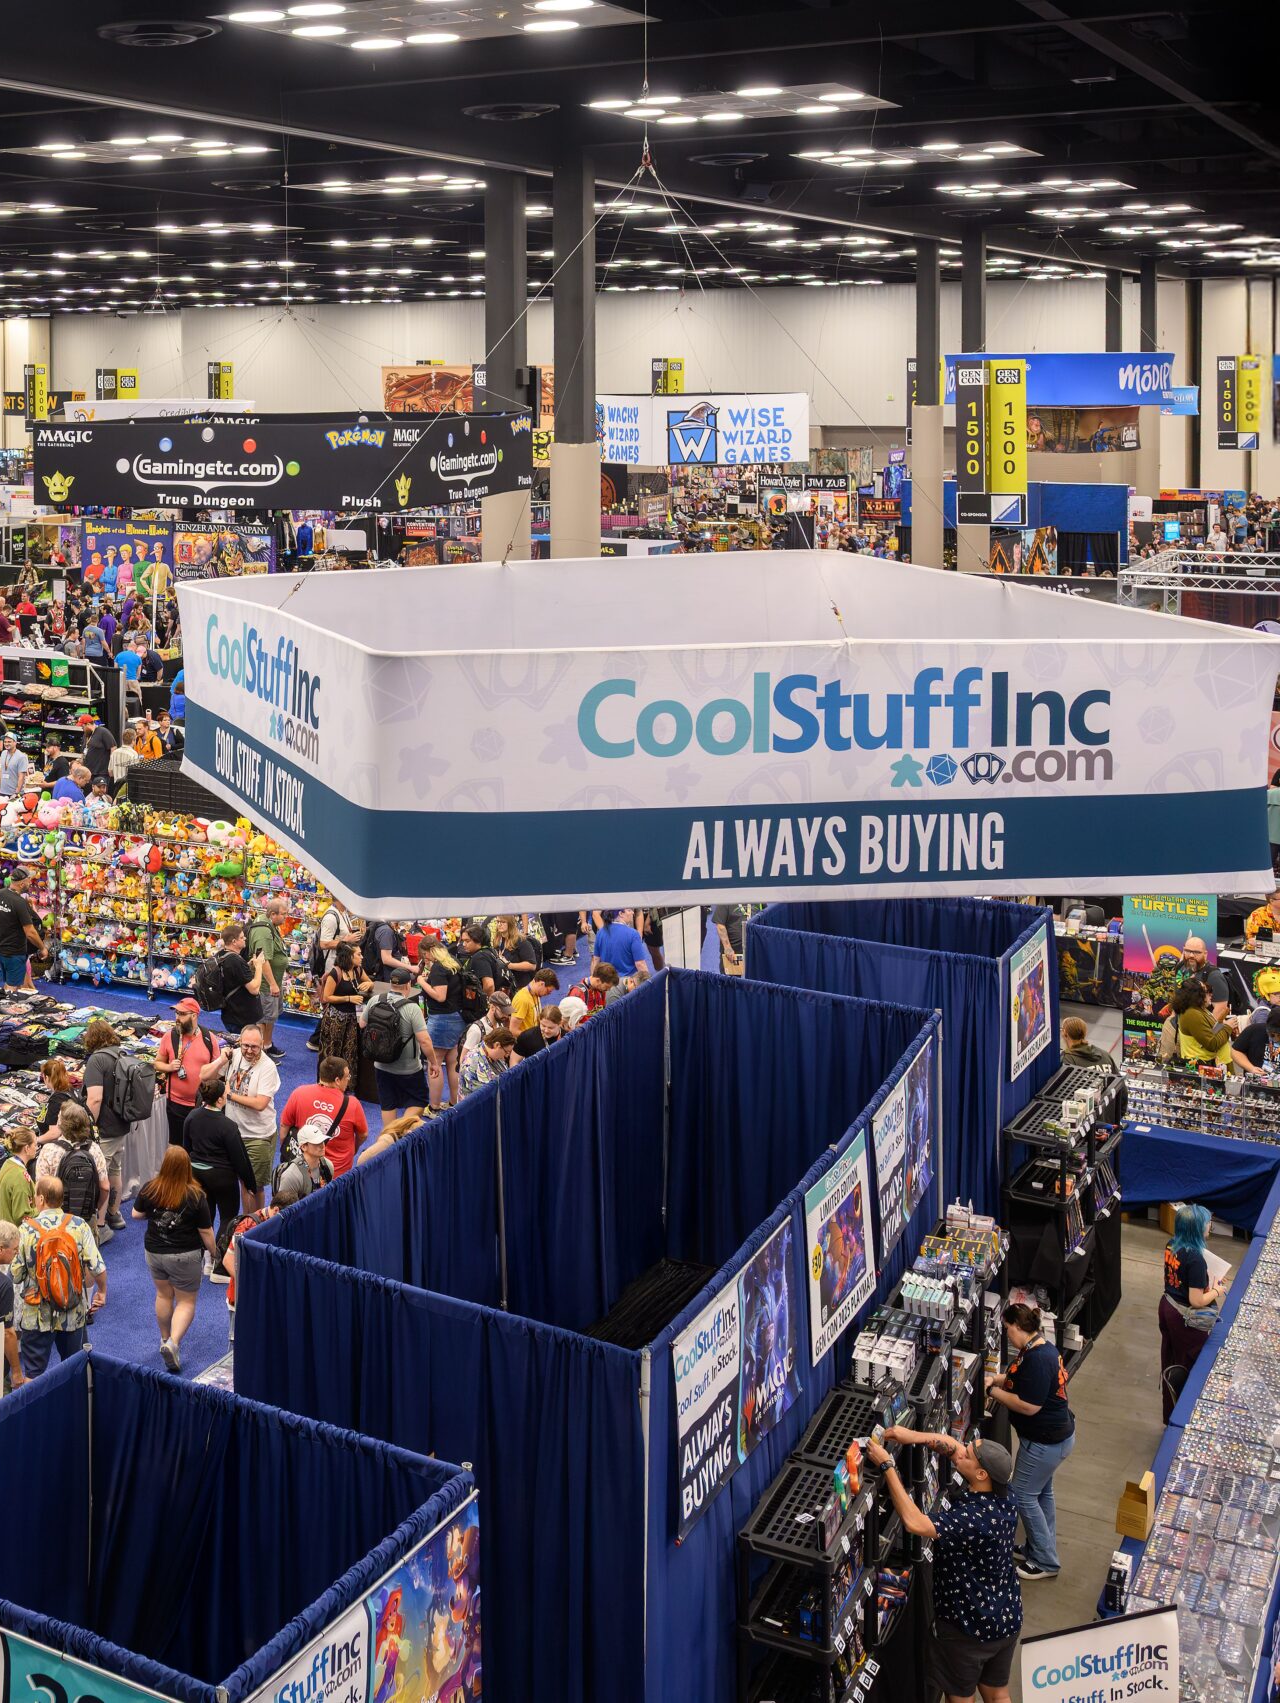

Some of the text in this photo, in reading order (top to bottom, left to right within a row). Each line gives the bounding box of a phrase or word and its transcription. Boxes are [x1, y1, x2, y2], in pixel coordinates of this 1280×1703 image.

[962, 370, 981, 378] GEN
[962, 377, 981, 385] CON
[997, 370, 1018, 378] GEN
[1223, 380, 1231, 422] 1500
[608, 406, 639, 423] WACKY
[728, 407, 785, 427] WISE
[37, 429, 93, 443] MAGIC
[393, 429, 420, 442] MAGIC
[608, 427, 639, 443] WIZARD
[723, 429, 792, 447] WIZARD
[966, 401, 980, 475] 1500
[1003, 401, 1016, 475] 1500
[440, 450, 495, 471] Gamingetc.com
[609, 446, 639, 464] GAMES
[725, 447, 792, 465] GAMES
[139, 459, 277, 478] Gamingetc.com
[518, 476, 532, 485] Plush
[760, 475, 802, 488] Howard Tayler
[807, 478, 846, 488] JIM ZUB
[158, 494, 255, 507] True Dungeon
[342, 496, 381, 508] Plush
[449, 485, 489, 500] True Dungeon
[86, 522, 111, 534] Knights
[176, 524, 208, 532] KENZER
[208, 525, 226, 533] AND
[206, 614, 320, 730] CoolStuffInc
[576, 666, 1112, 760] CoolStuffInc
[294, 723, 320, 765] .com
[1002, 748, 1113, 784] .com
[215, 726, 306, 840] COOL STUFF. IN STOCK.
[683, 811, 1005, 881] ALWAYS BUYING
[1131, 898, 1209, 917] TURTLES
[820, 1168, 858, 1222] LIMITED EDITION
[812, 1252, 822, 1274] $30
[815, 1274, 875, 1357] GEN CON 2025 PLAYMAT!
[675, 1302, 736, 1383] CoolStuffInc
[754, 1348, 794, 1414] MAGIC
[682, 1394, 732, 1479] ALWAYS
[682, 1434, 732, 1520] BUYING
[1032, 1643, 1168, 1690] CoolStuffInc
[1139, 1659, 1168, 1672] .com
[1111, 1674, 1168, 1702] In Stock.
